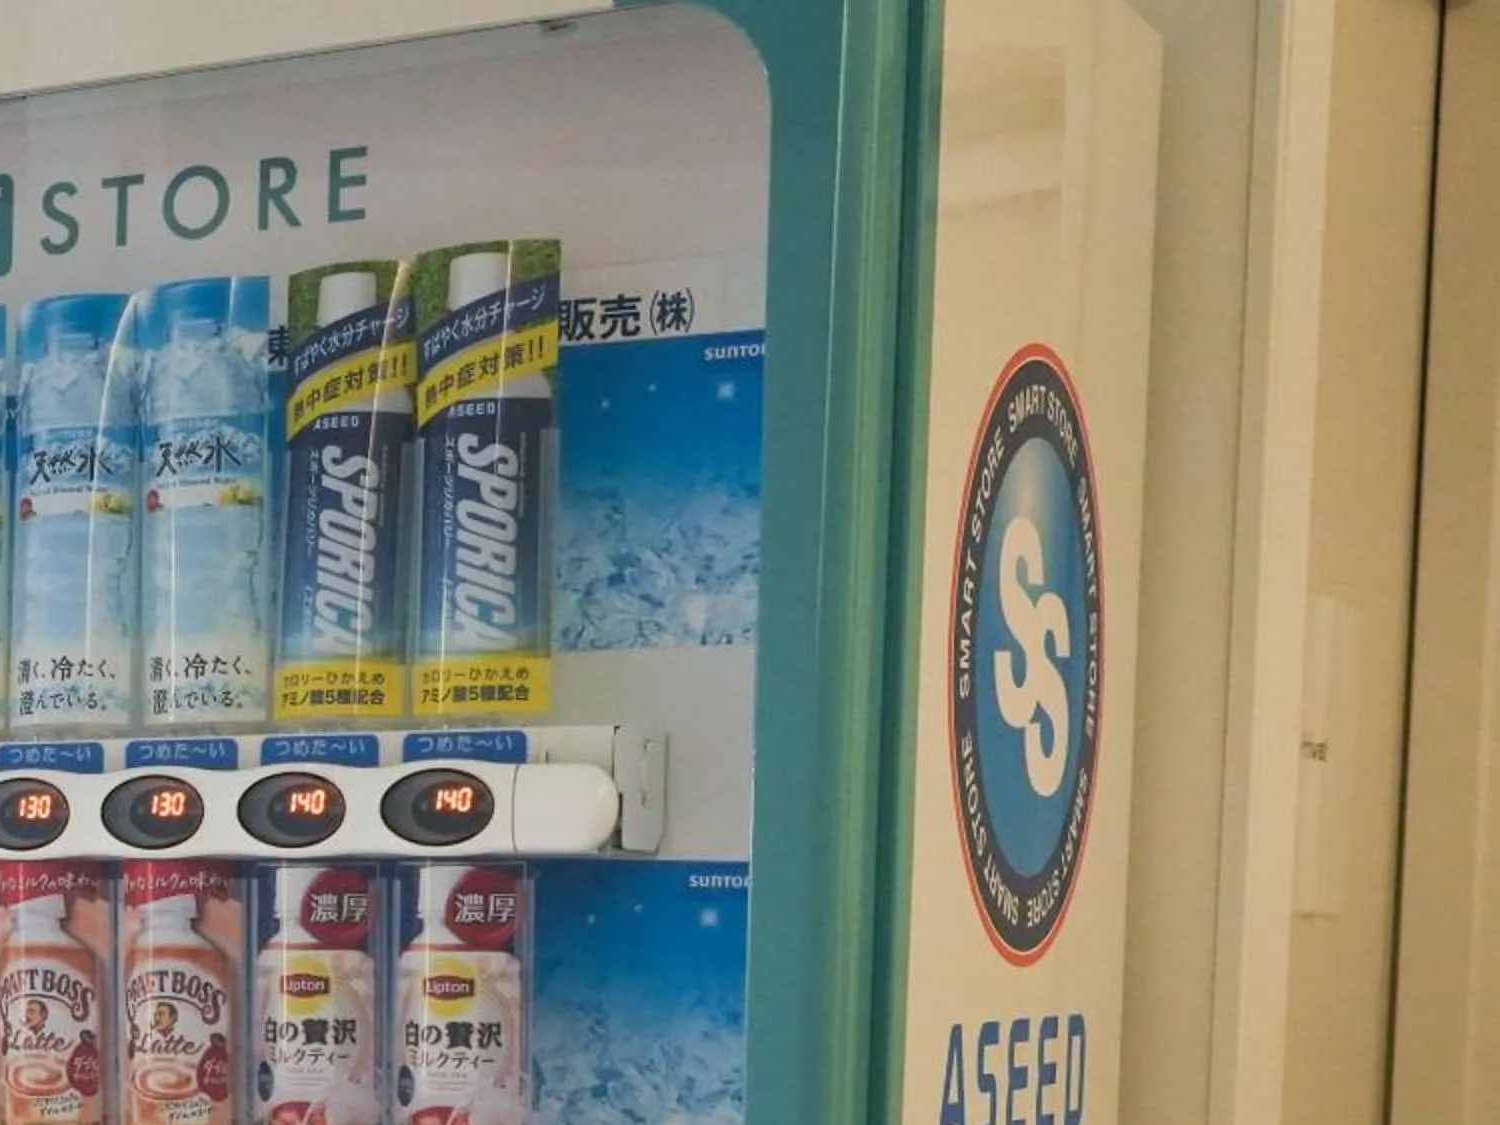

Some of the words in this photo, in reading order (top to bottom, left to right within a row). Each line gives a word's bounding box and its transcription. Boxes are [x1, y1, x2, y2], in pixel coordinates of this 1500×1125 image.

[41, 147, 367, 256] STORE
[449, 401, 497, 418] ASEED
[313, 415, 360, 430] ASEED
[30, 444, 114, 485] 天然水
[157, 436, 242, 477] 天然水
[19, 795, 51, 819] 130
[151, 792, 185, 816] 130
[289, 789, 325, 815] 140
[435, 787, 474, 812] 140
[310, 893, 368, 922] 濃厚
[455, 893, 518, 924] 濃厚
[283, 977, 325, 993] Lipton
[426, 980, 470, 996] Lipton
[269, 1047, 350, 1066] ミルクティー
[410, 1050, 495, 1070] ミルクティー
